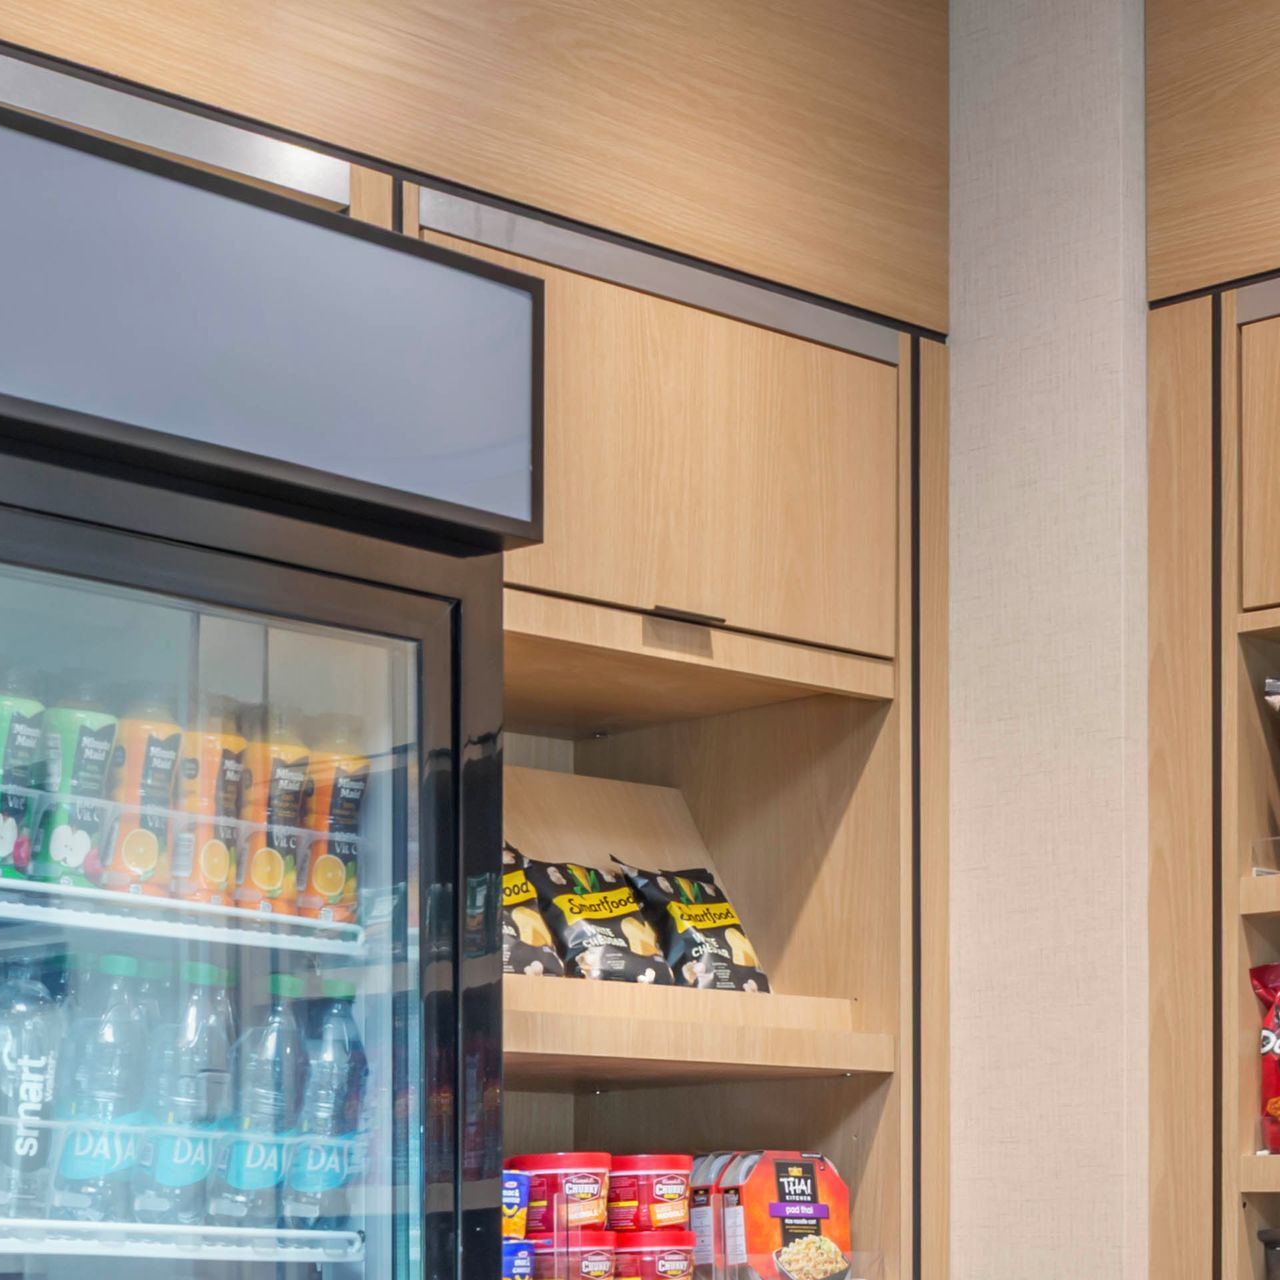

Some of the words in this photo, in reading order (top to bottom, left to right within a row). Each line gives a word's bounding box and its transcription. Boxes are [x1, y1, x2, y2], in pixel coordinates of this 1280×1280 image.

[15, 1052, 47, 1157] smart
[779, 1177, 812, 1195] THAI
[785, 1206, 800, 1215] pad
[801, 1206, 814, 1214] thai
